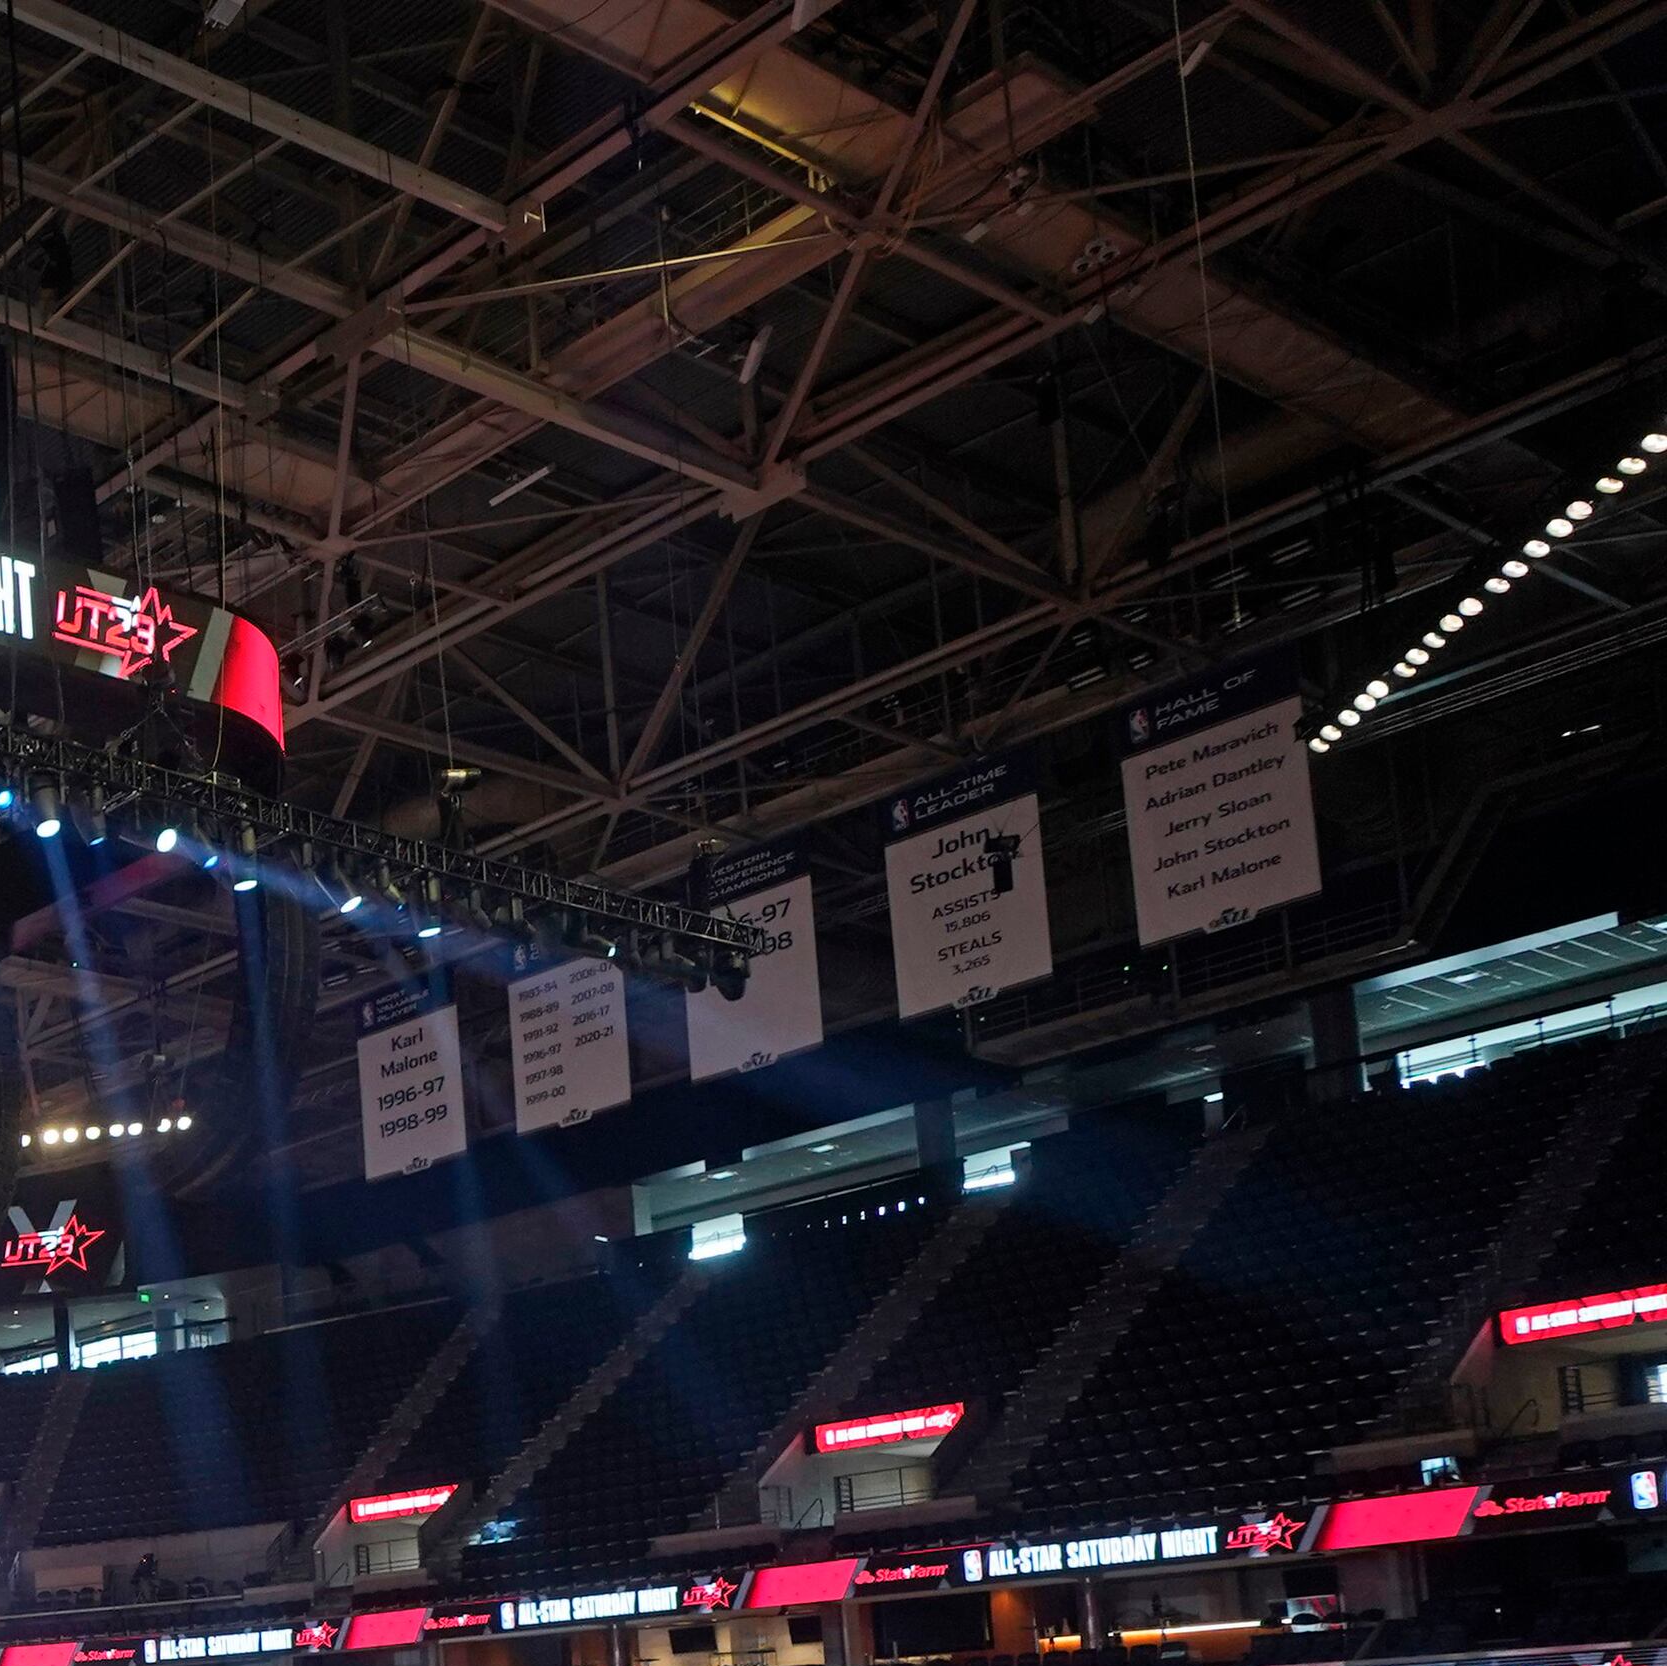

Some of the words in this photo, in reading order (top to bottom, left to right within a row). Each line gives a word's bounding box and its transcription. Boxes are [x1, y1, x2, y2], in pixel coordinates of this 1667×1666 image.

[1154, 681, 1218, 717] HALL
[1223, 668, 1258, 688] OF
[1156, 698, 1221, 732] FAME
[1144, 754, 1187, 781] Pete
[1192, 720, 1280, 763] Maravich
[913, 764, 1008, 807] ALL-TIME
[1144, 780, 1208, 811] Adrian
[1211, 752, 1286, 789] Dantley
[915, 782, 995, 820] LEADER
[1163, 811, 1213, 839] Jerry
[1216, 789, 1273, 817] Sloan
[931, 824, 990, 861] John
[1153, 845, 1200, 873] John
[1204, 816, 1291, 857] Stockton
[1166, 873, 1207, 900] Karl
[1210, 851, 1283, 883] Malone
[931, 887, 1002, 921] ASSISTS
[937, 930, 1003, 963] STEALS
[390, 1027, 424, 1052] Karl
[380, 1050, 439, 1079] Malone
[376, 1075, 446, 1112] 1996-97
[379, 1103, 449, 1139] 1998-99
[1066, 1532, 1157, 1568] SATURDAY
[1160, 1525, 1218, 1559] NIGHT
[572, 1591, 636, 1620] SATURDAY
[637, 1586, 678, 1613] NIGHT
[207, 1632, 260, 1657] SATURDAY
[260, 1628, 293, 1652] NIGHT
